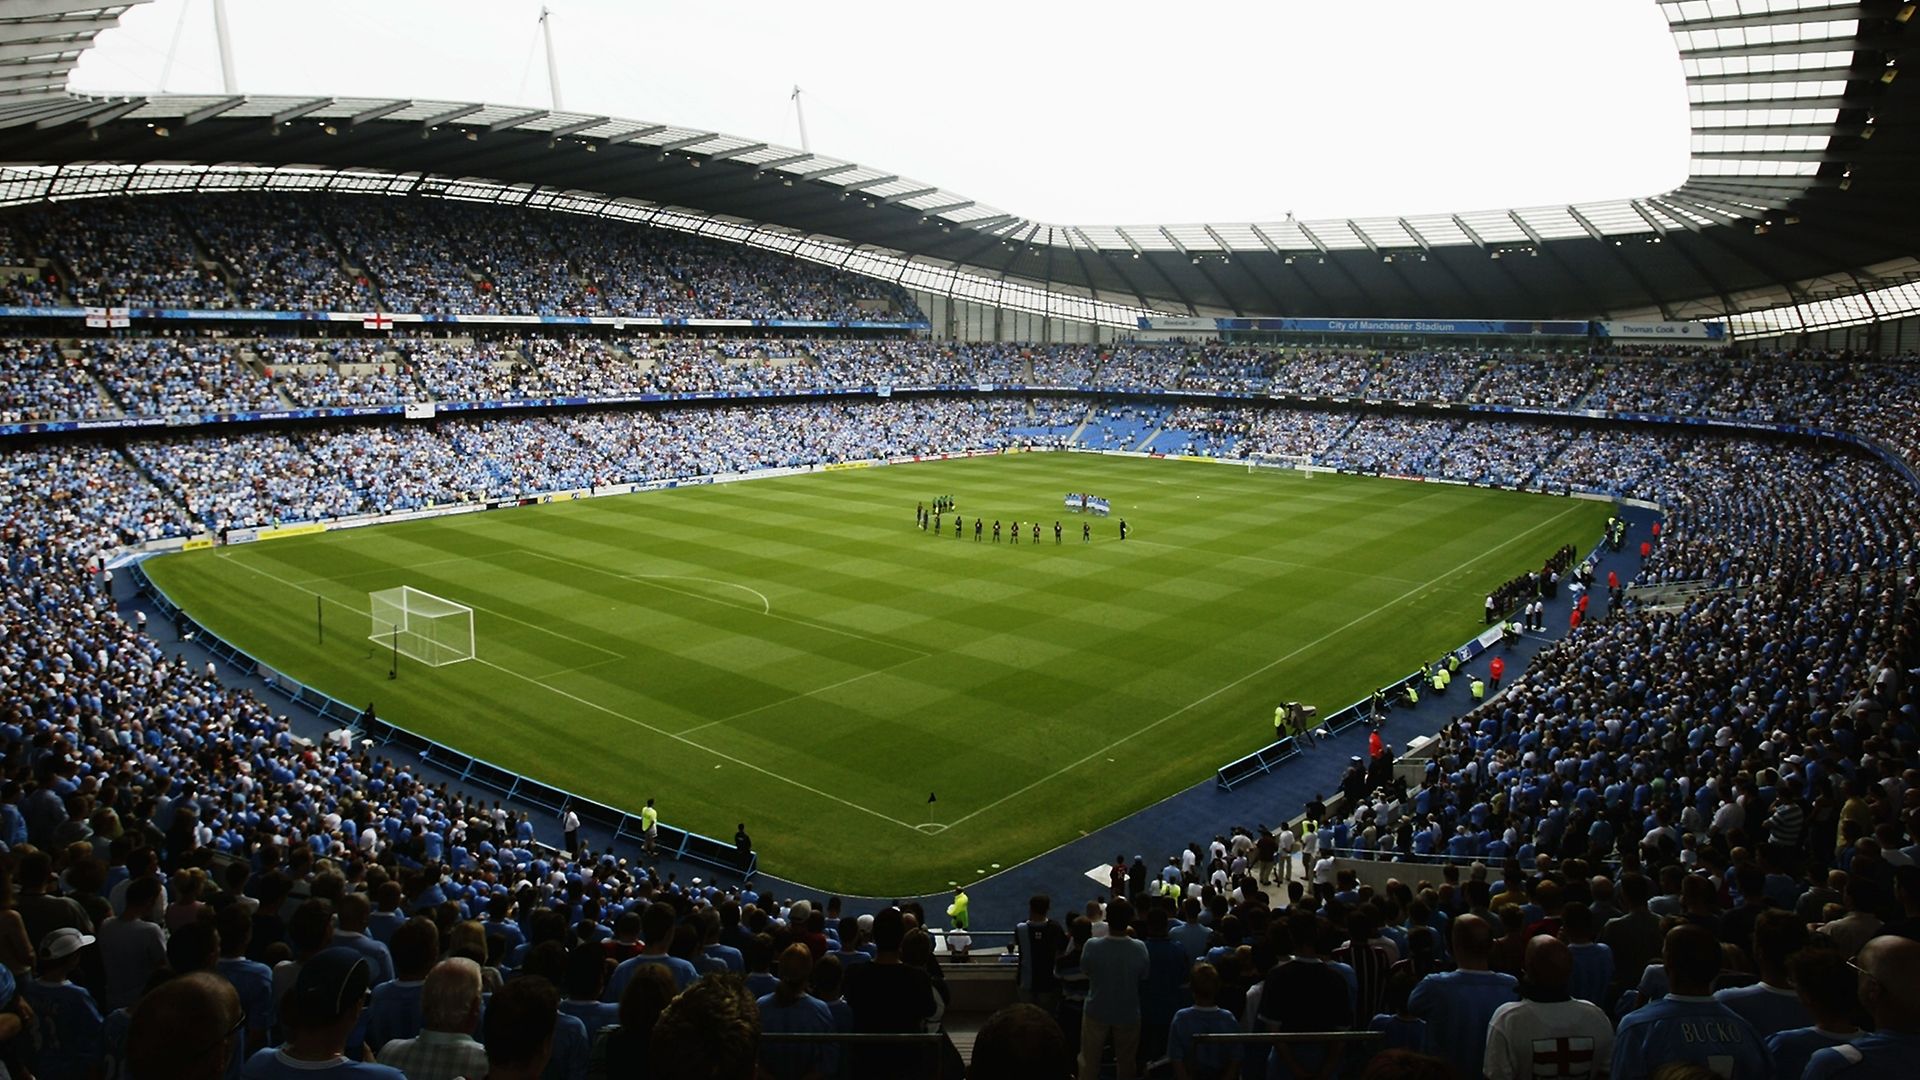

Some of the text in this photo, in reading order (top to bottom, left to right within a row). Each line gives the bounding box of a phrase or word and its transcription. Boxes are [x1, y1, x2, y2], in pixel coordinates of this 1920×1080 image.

[1328, 321, 1455, 331] City of Manchester Stadium
[1623, 325, 1675, 333] Thomas Cook
